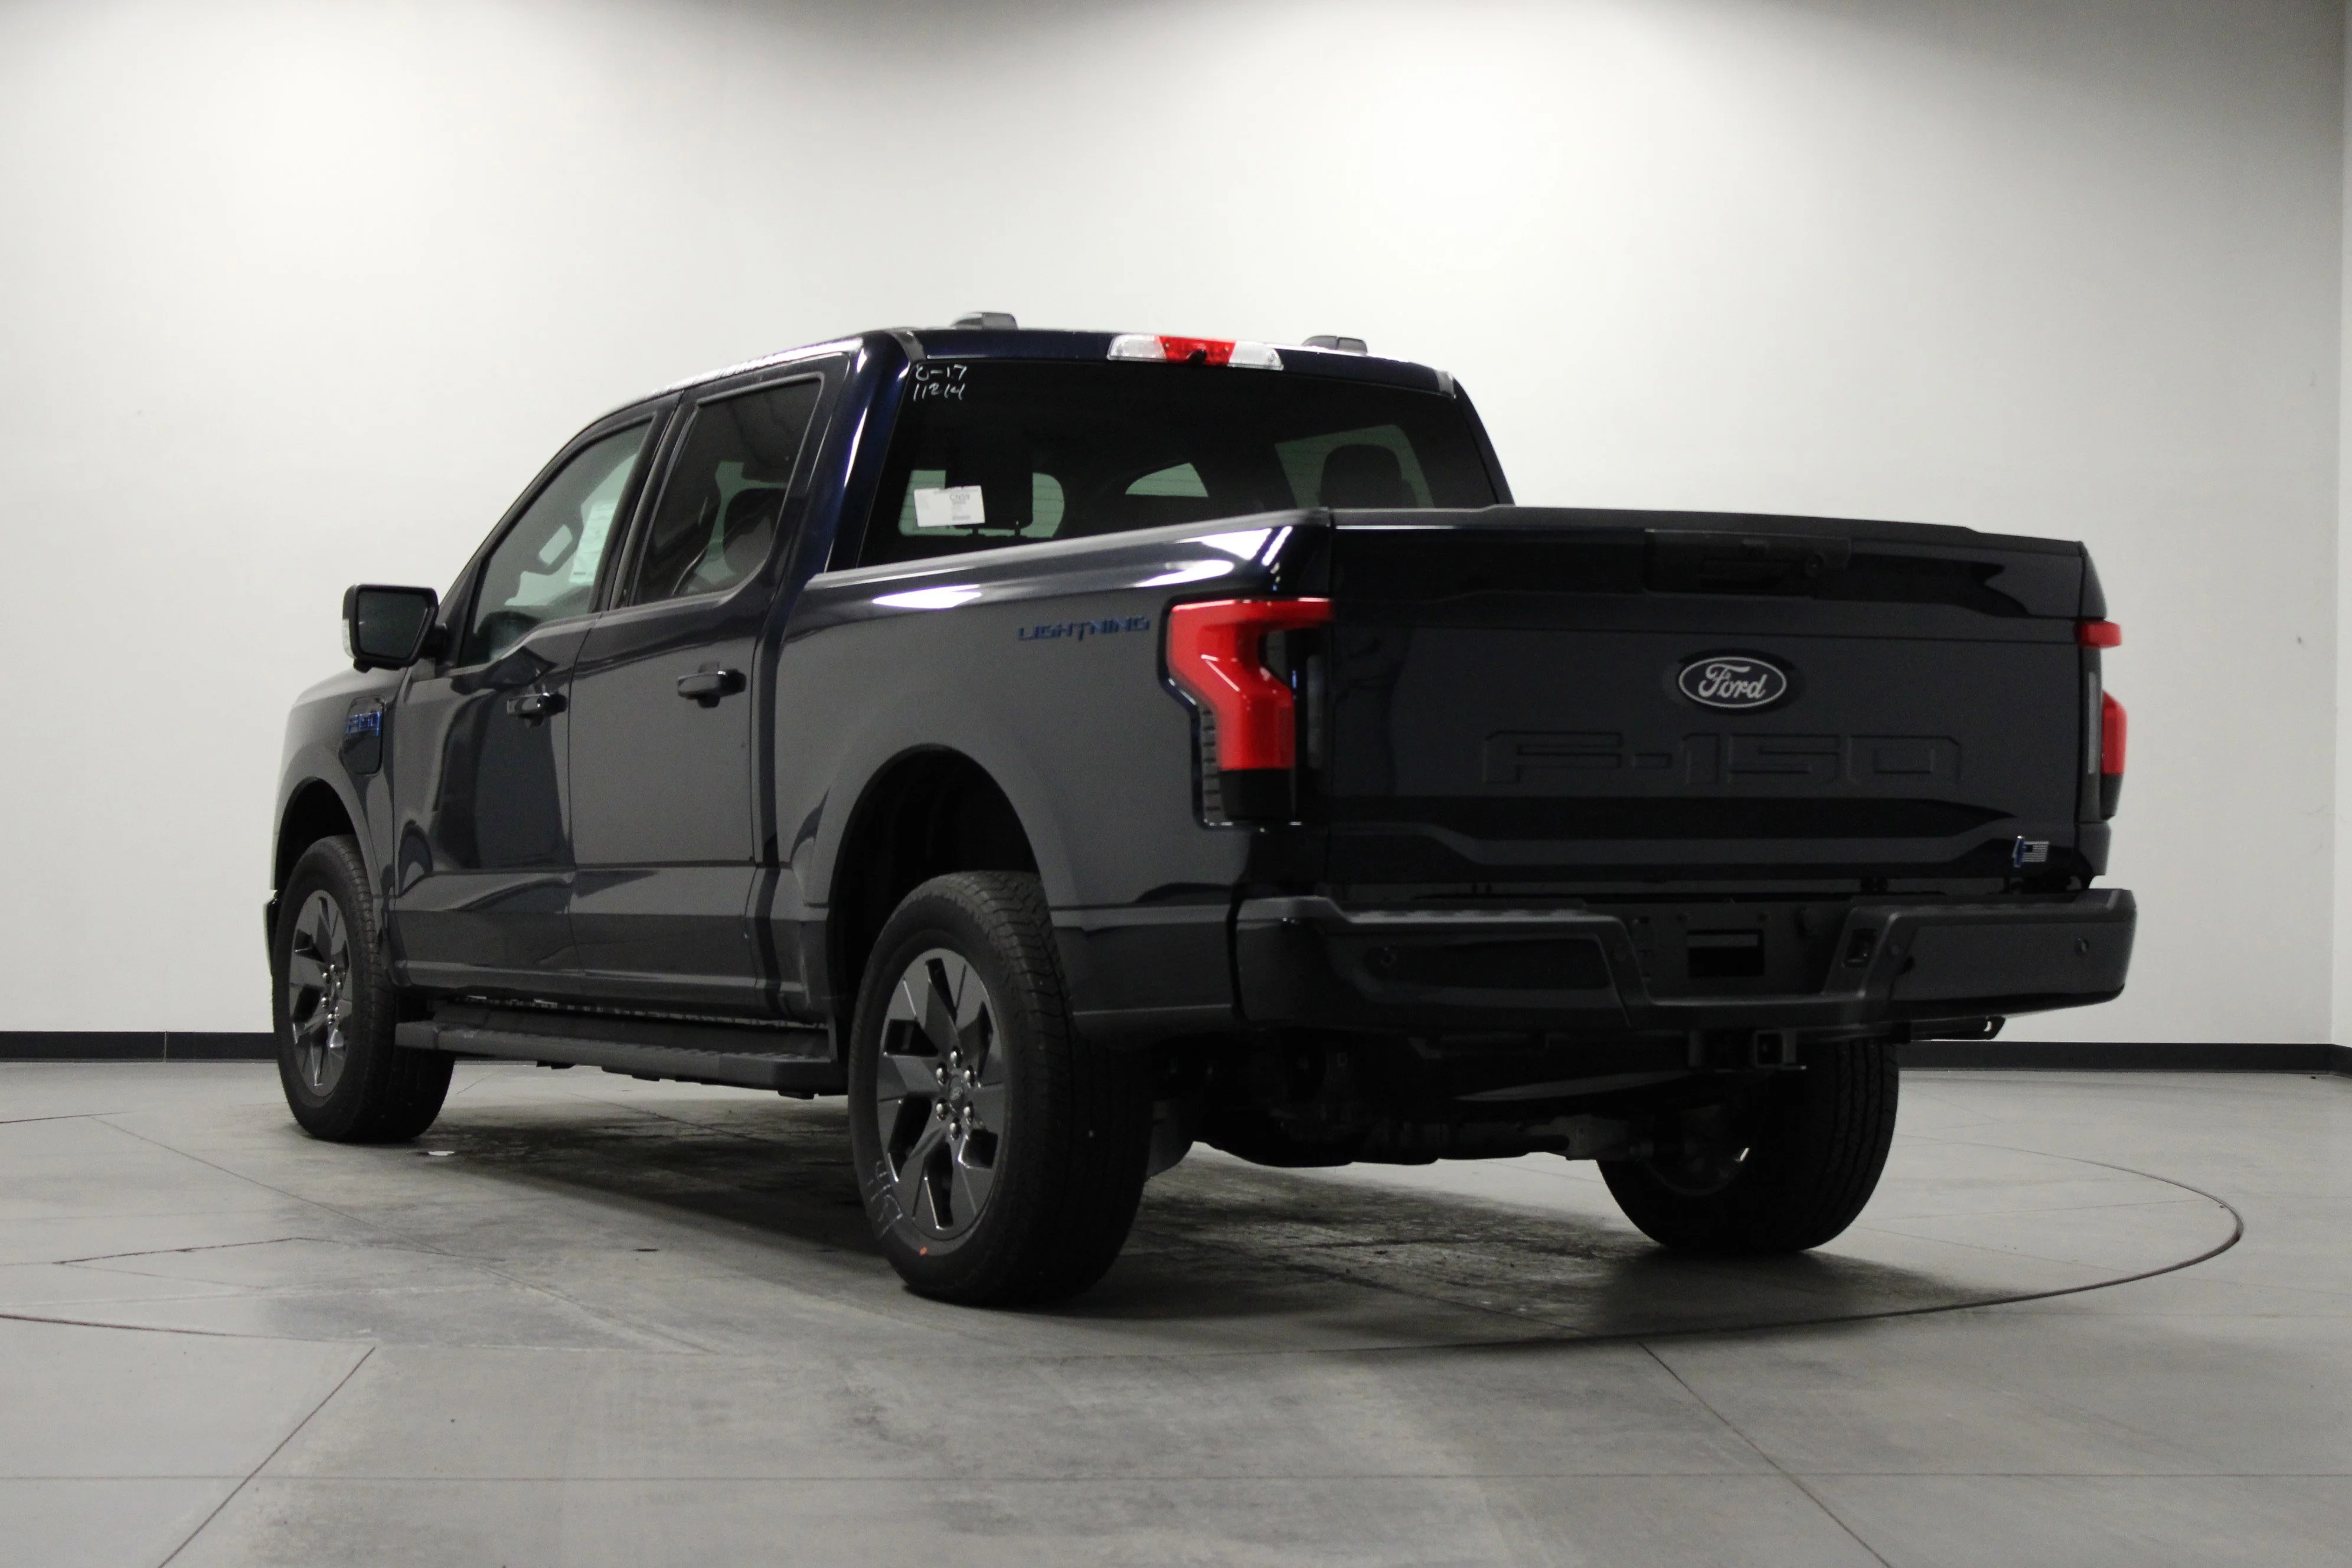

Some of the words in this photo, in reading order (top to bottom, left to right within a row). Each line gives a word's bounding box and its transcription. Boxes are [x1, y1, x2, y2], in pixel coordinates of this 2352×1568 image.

[1018, 616, 1150, 641] LIGHTNING
[1697, 662, 1769, 699] Ford
[1483, 730, 1962, 785] F-150
